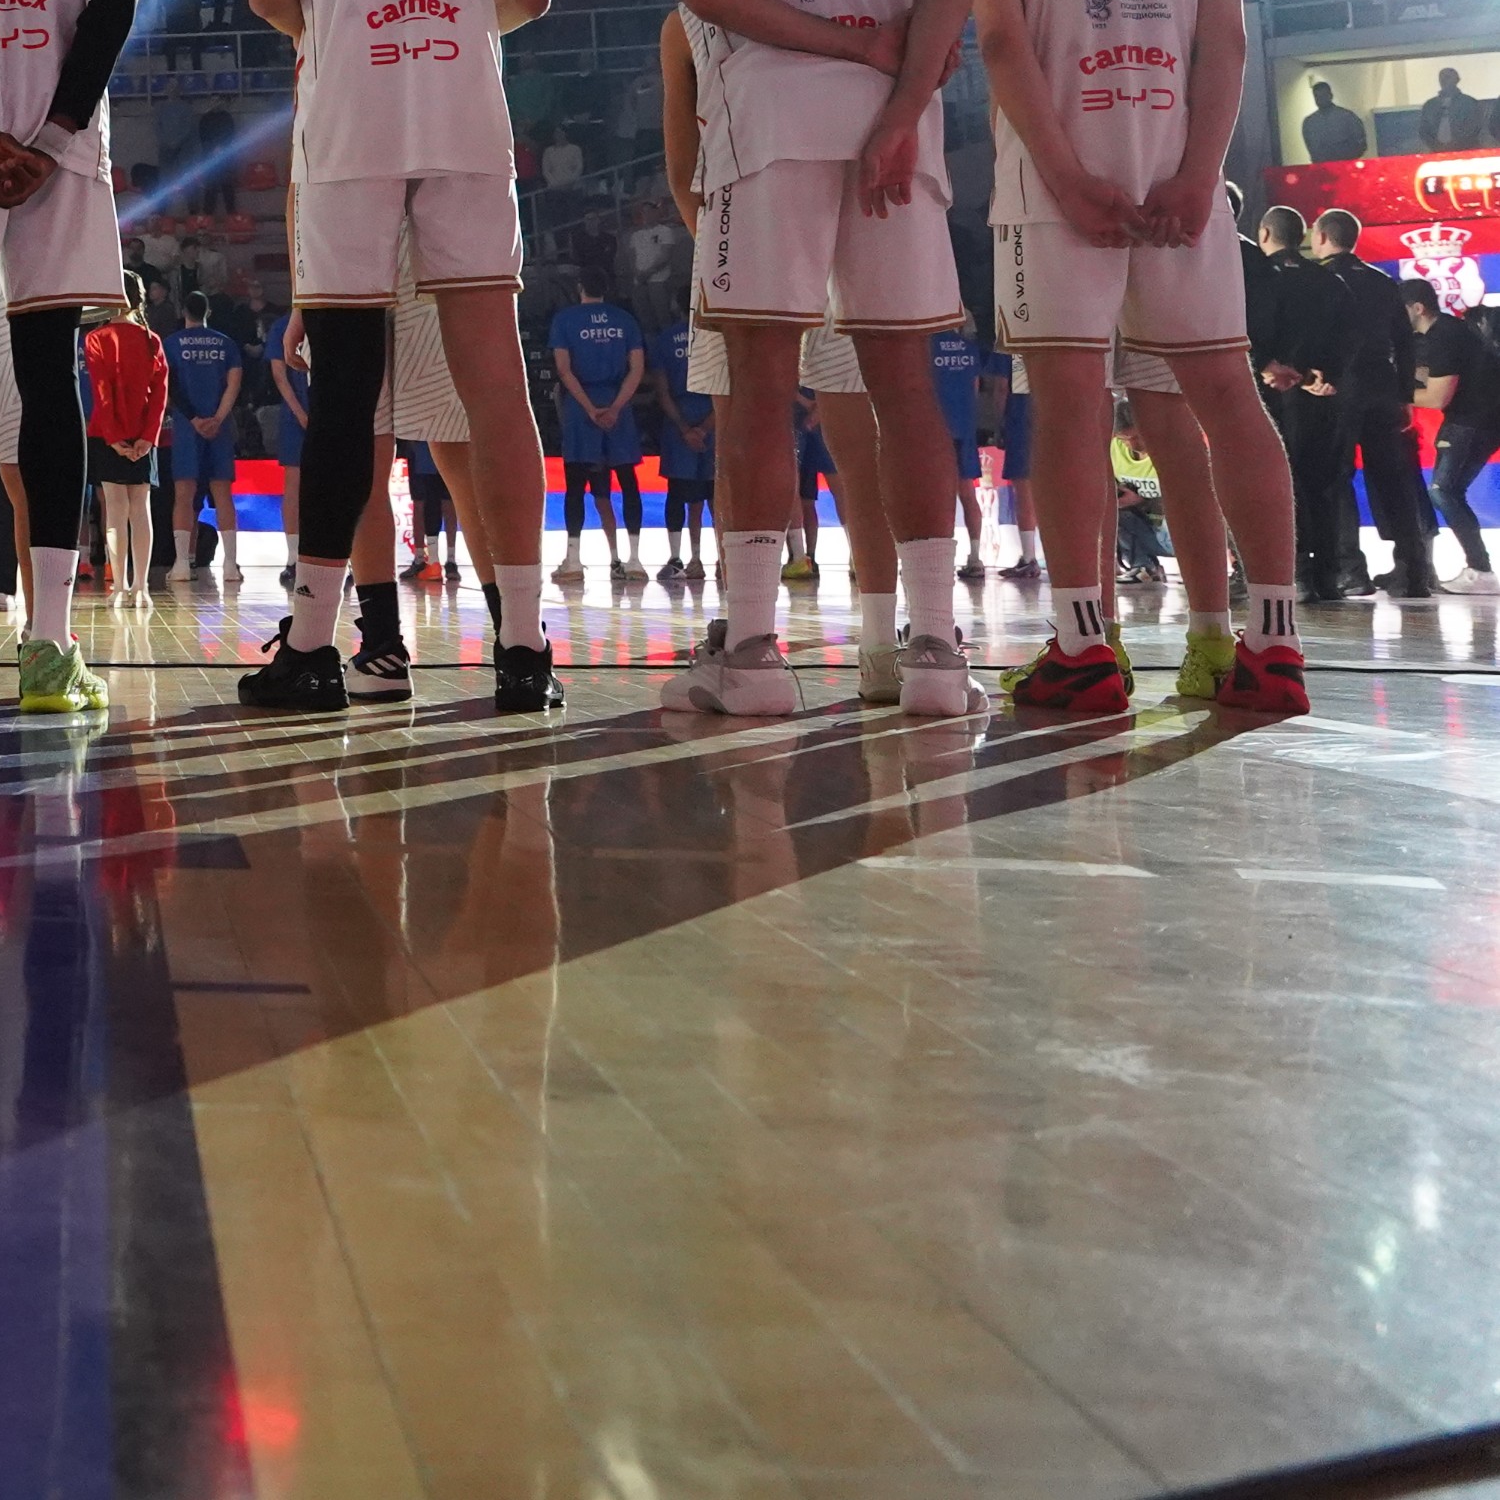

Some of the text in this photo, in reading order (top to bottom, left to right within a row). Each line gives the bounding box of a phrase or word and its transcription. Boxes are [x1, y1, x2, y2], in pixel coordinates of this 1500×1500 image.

[1078, 45, 1178, 75] carnex
[580, 328, 623, 339] OFFICE
[180, 337, 223, 346] MOMIROV
[182, 350, 225, 360] OFFICE
